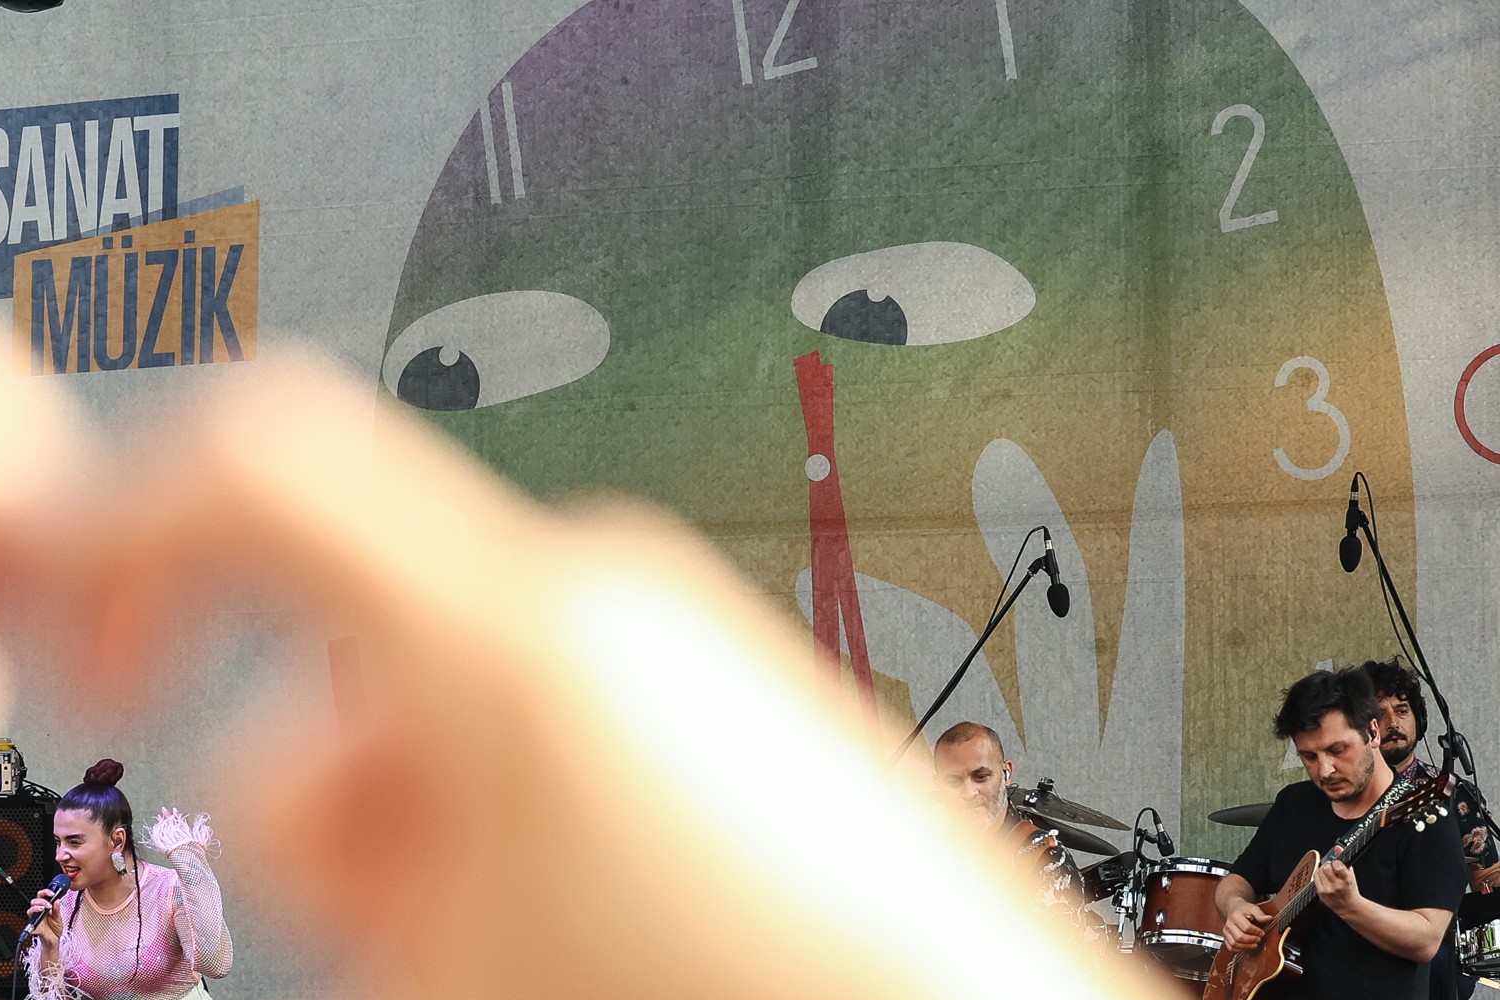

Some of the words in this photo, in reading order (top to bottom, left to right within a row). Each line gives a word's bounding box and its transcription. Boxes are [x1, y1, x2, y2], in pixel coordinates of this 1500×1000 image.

[1210, 104, 1279, 232] 2
[30, 230, 246, 376] MÜZİK
[1272, 356, 1351, 480] 3
